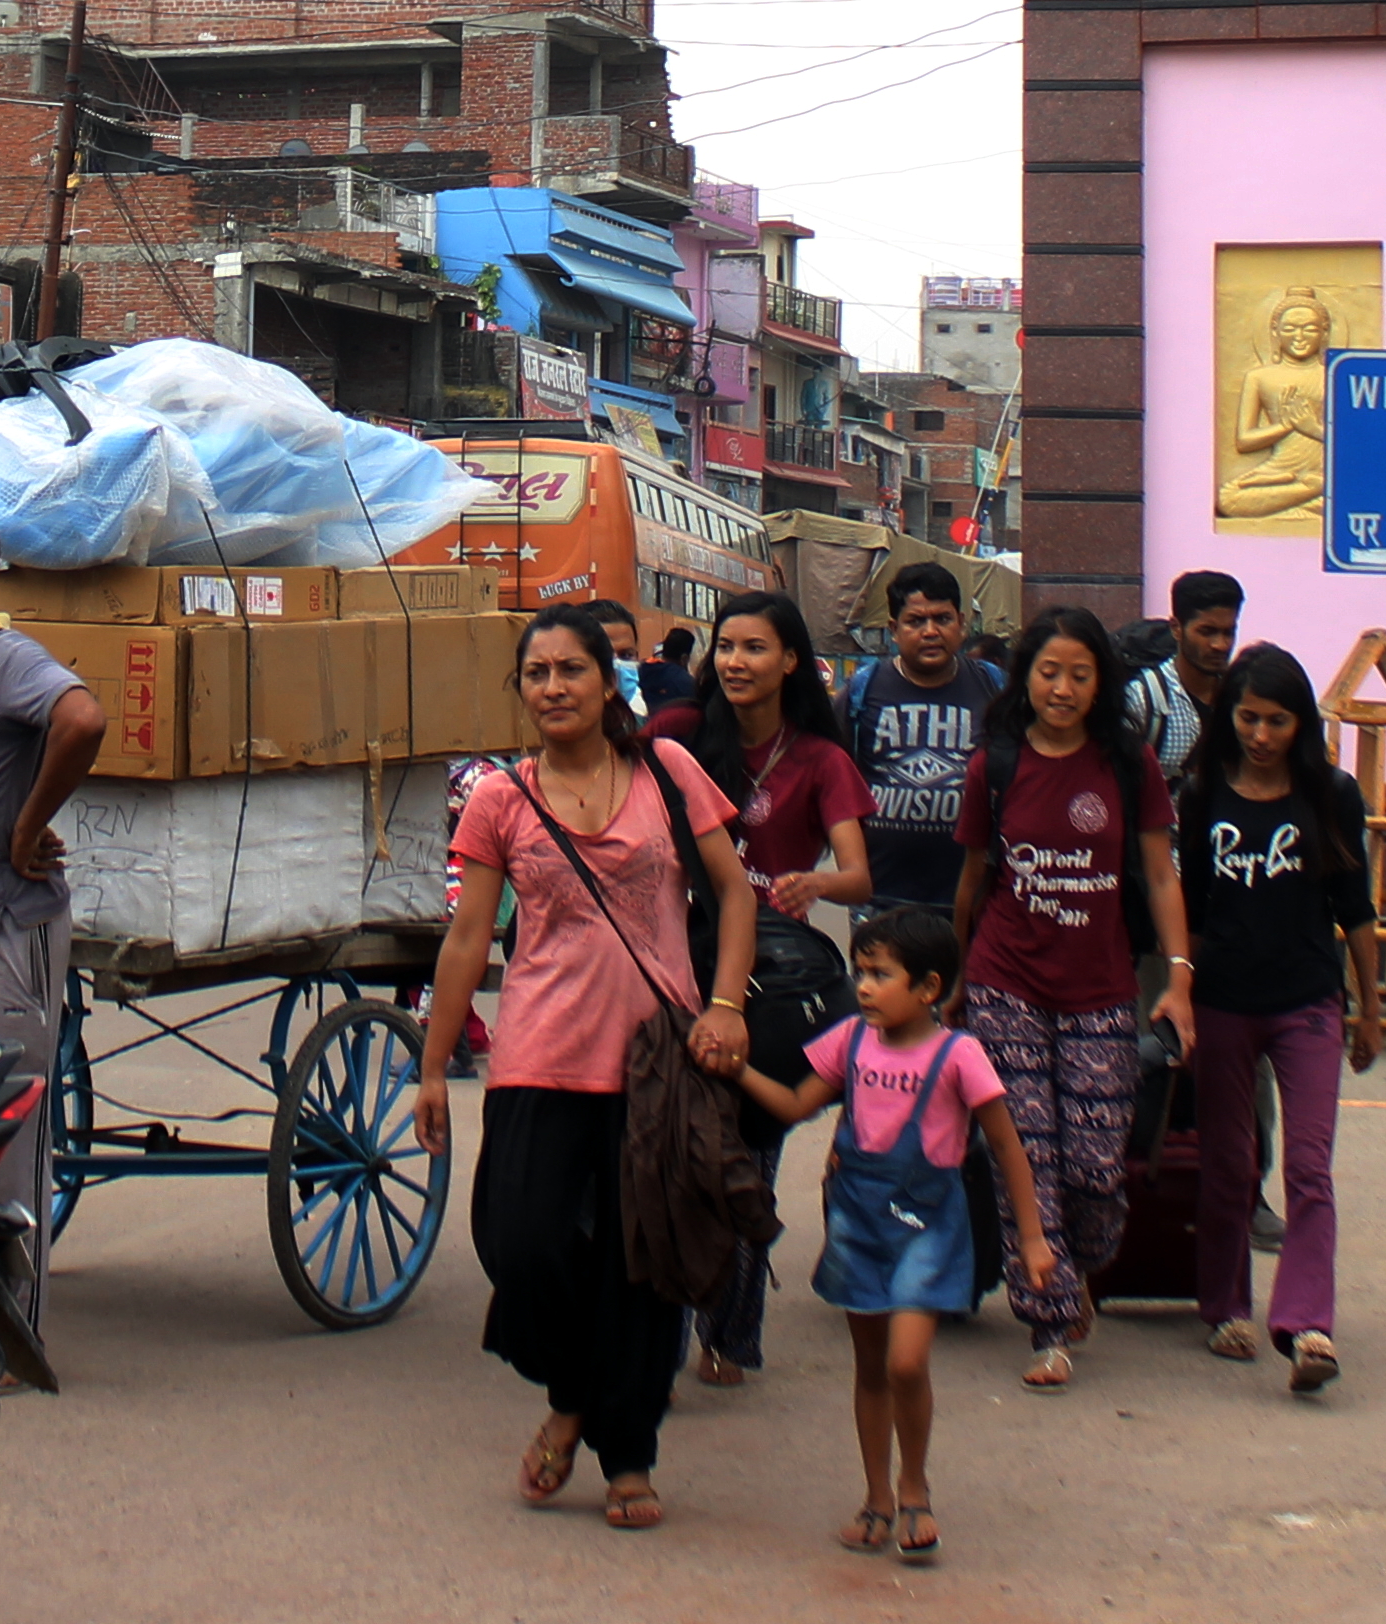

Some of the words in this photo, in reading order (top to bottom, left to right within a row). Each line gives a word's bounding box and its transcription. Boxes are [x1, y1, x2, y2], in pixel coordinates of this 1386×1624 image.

[1348, 512, 1381, 548] पर
[873, 703, 977, 753] ATHL
[70, 798, 138, 844] RZN
[871, 783, 965, 823] DIVISIO
[1038, 848, 1093, 869] World
[1029, 894, 1060, 918] Day
[853, 1060, 925, 1094] Youth
